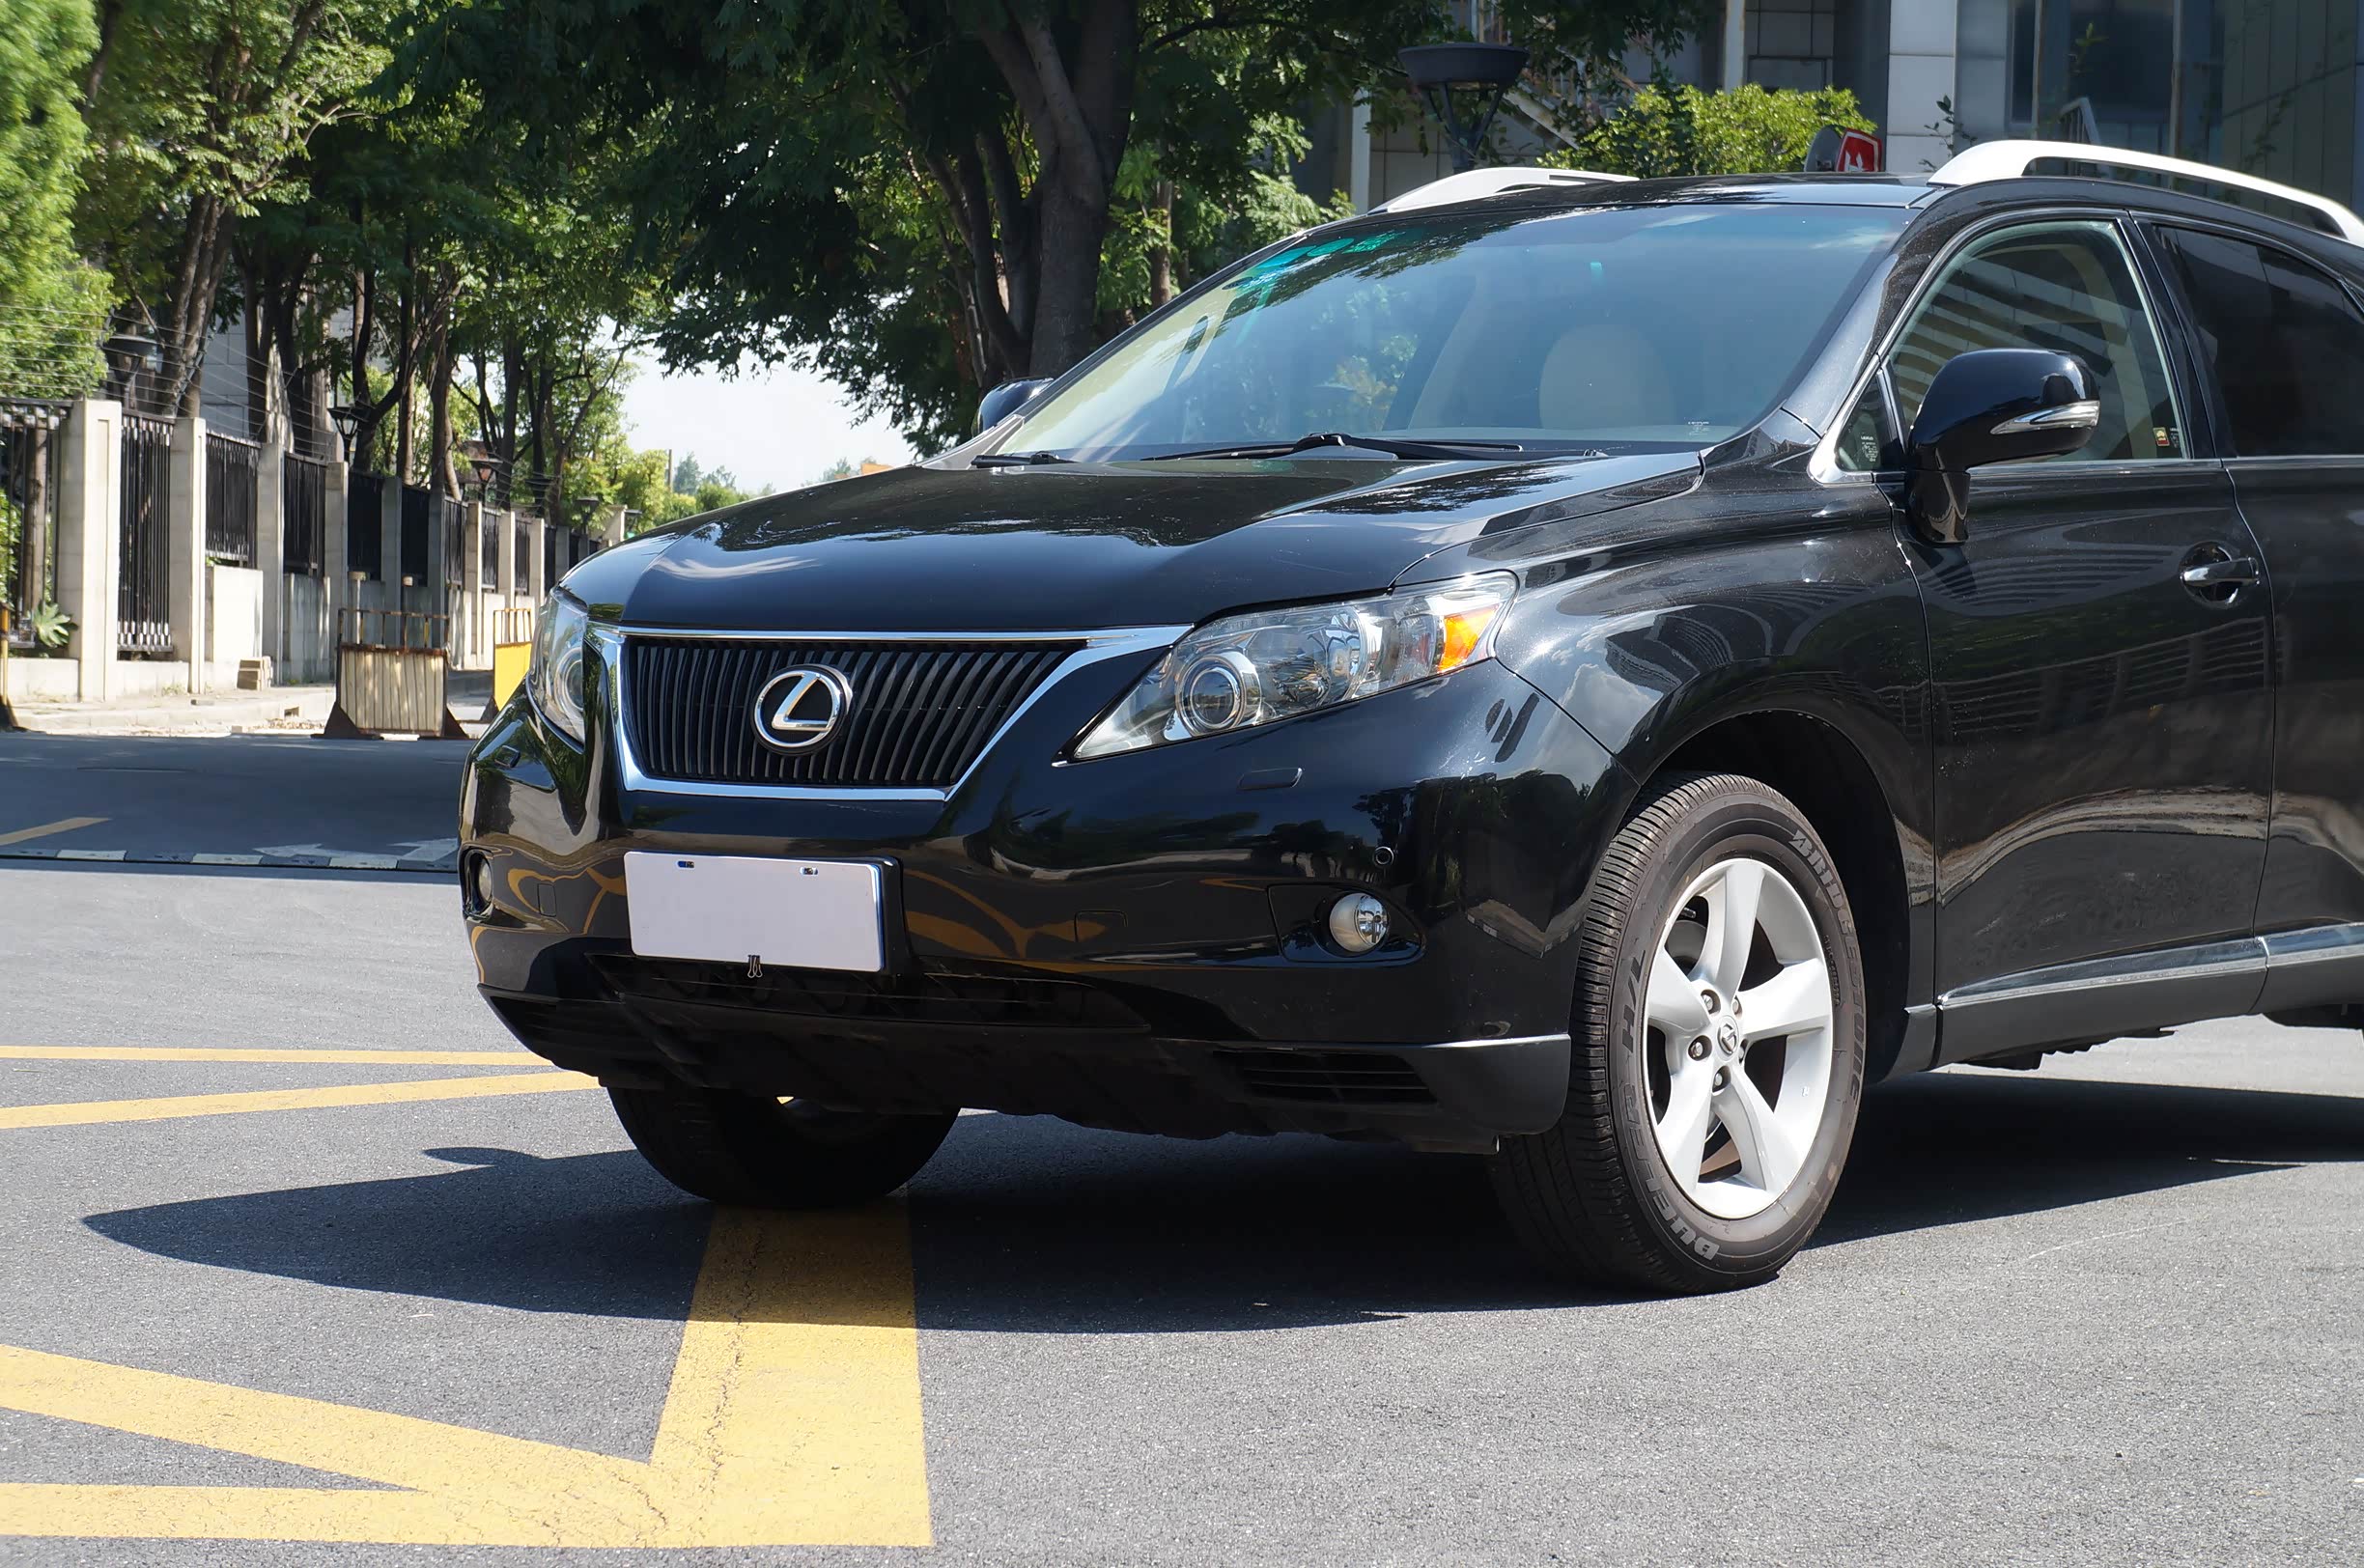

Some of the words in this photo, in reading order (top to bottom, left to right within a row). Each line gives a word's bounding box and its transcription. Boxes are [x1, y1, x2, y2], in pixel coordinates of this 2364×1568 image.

[1622, 949, 1646, 1053] H/L
[1788, 829, 1865, 1106] BRIDGESTONE
[1623, 1083, 1720, 1261] DUELER
